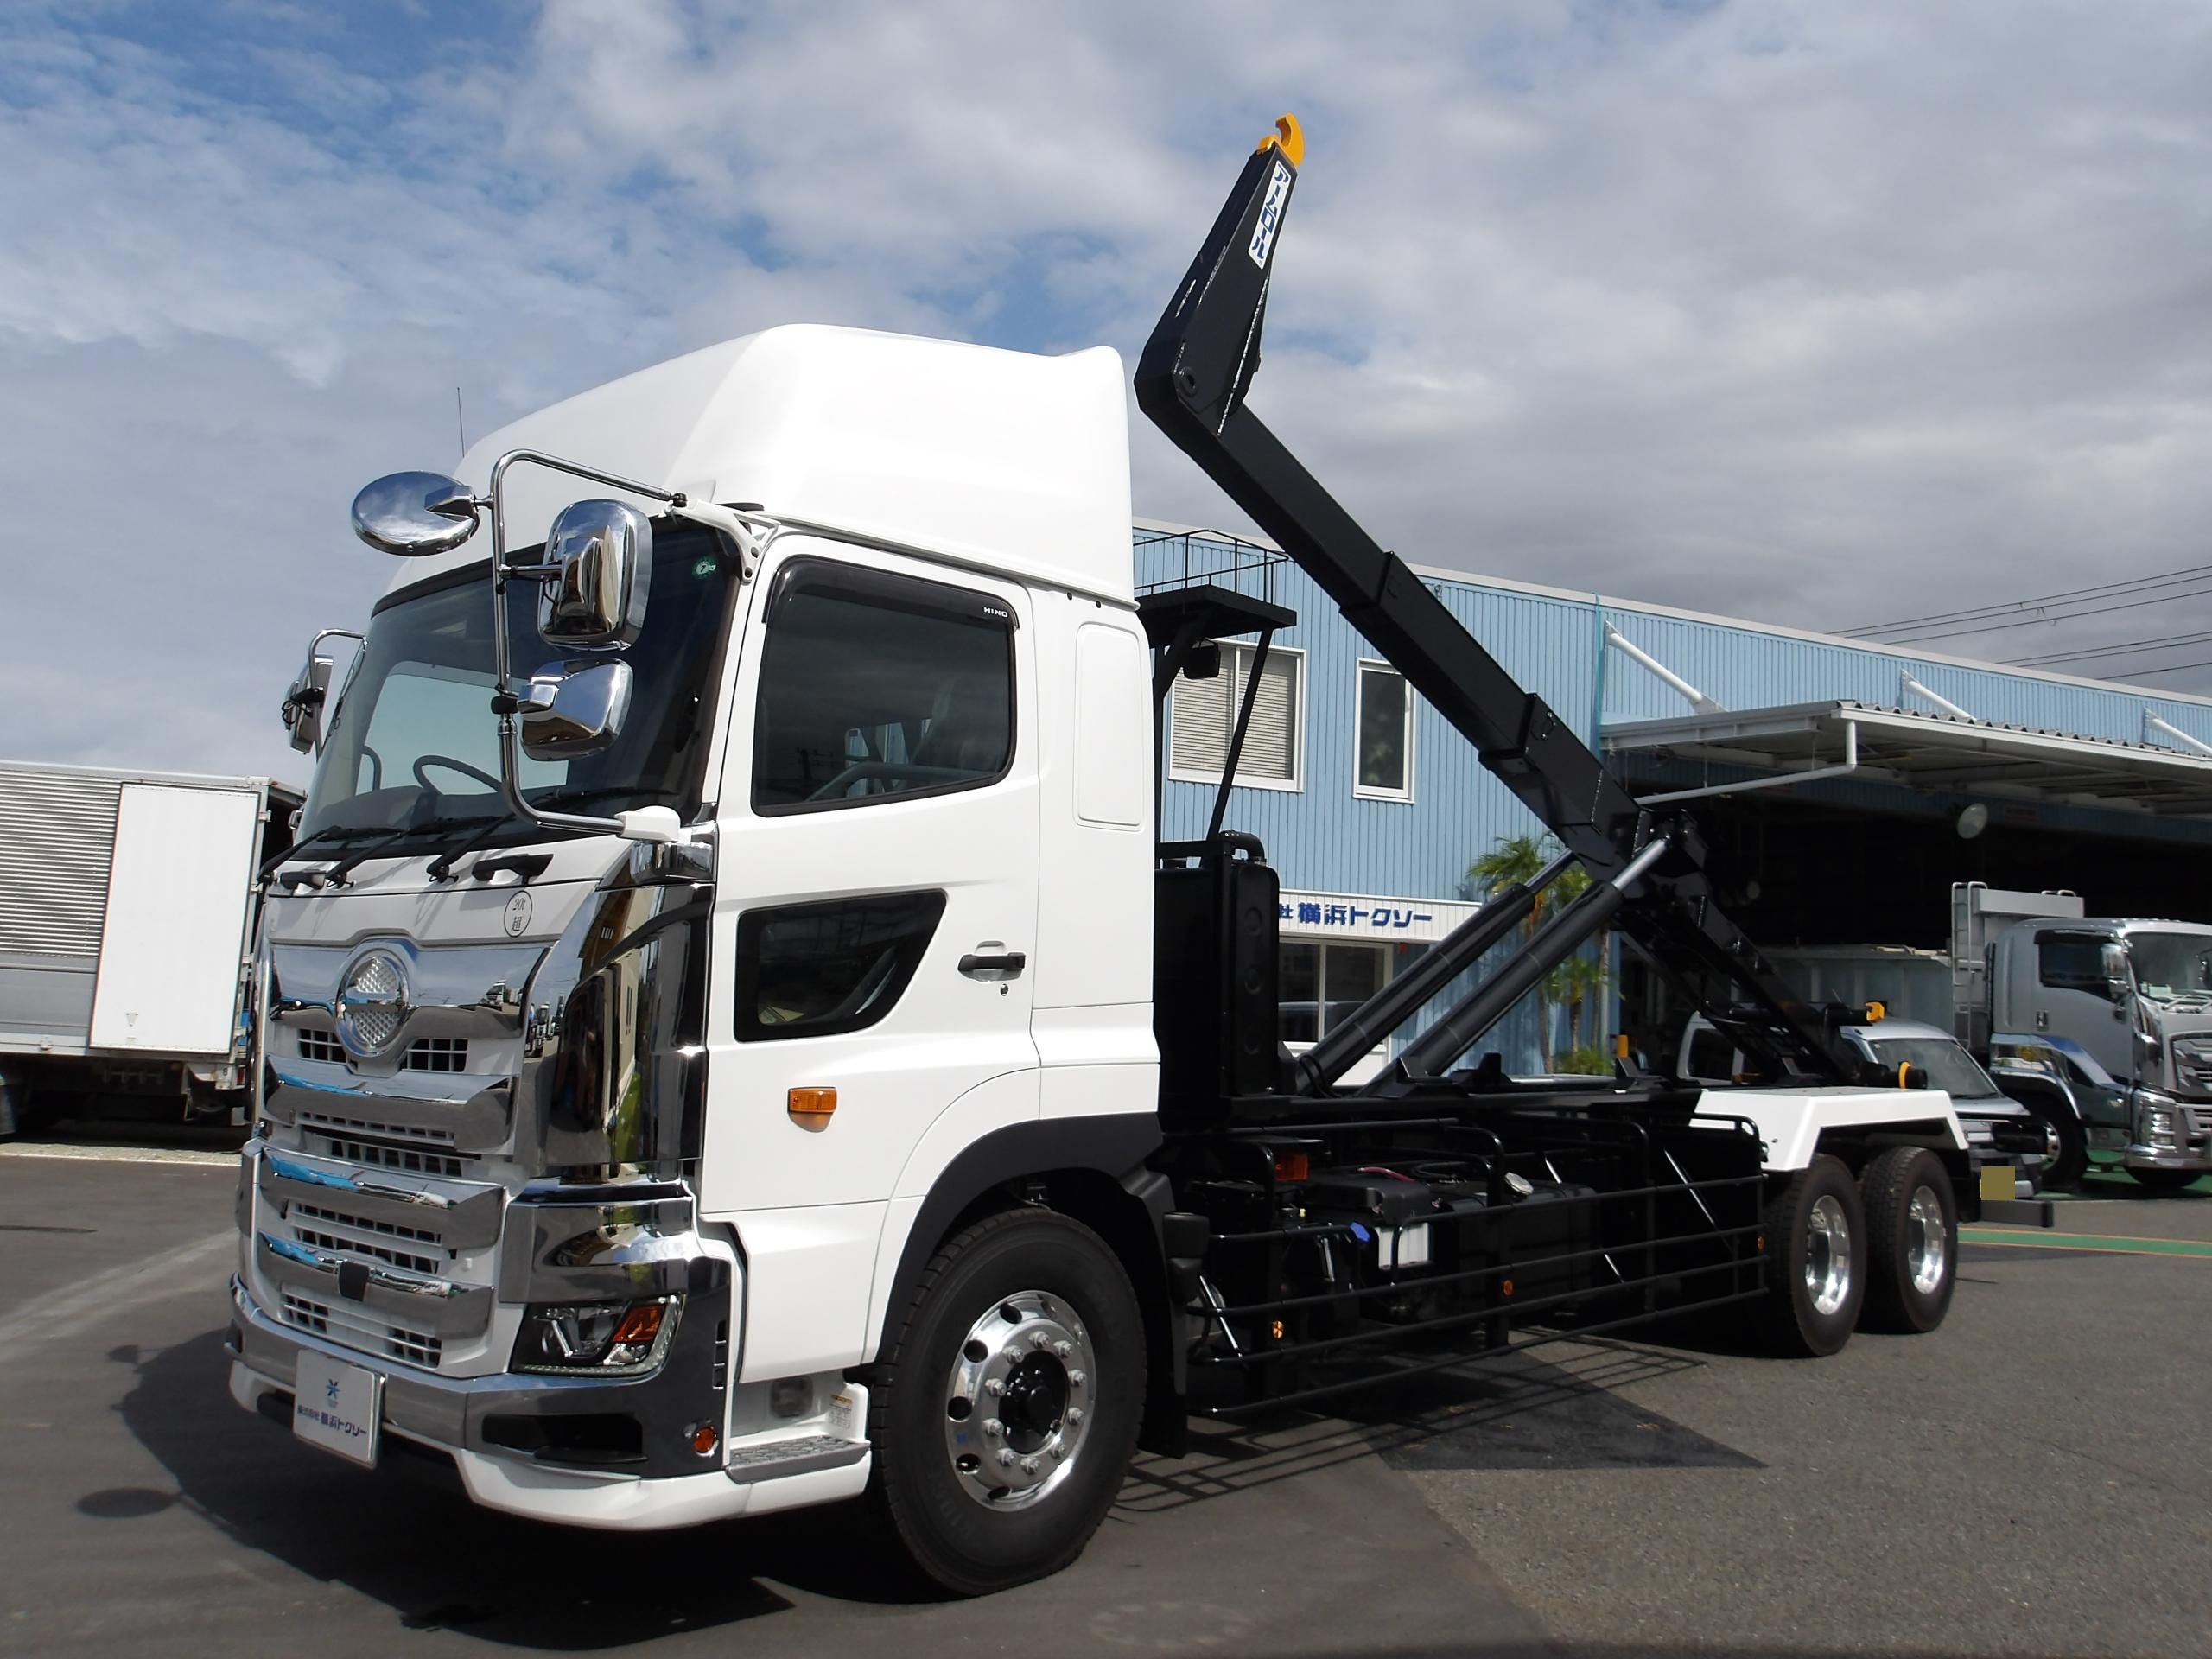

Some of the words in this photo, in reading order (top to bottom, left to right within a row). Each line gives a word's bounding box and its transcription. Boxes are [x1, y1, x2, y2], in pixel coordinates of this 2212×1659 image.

[1251, 162, 1289, 259] アームロール
[983, 607, 1008, 618] HINO
